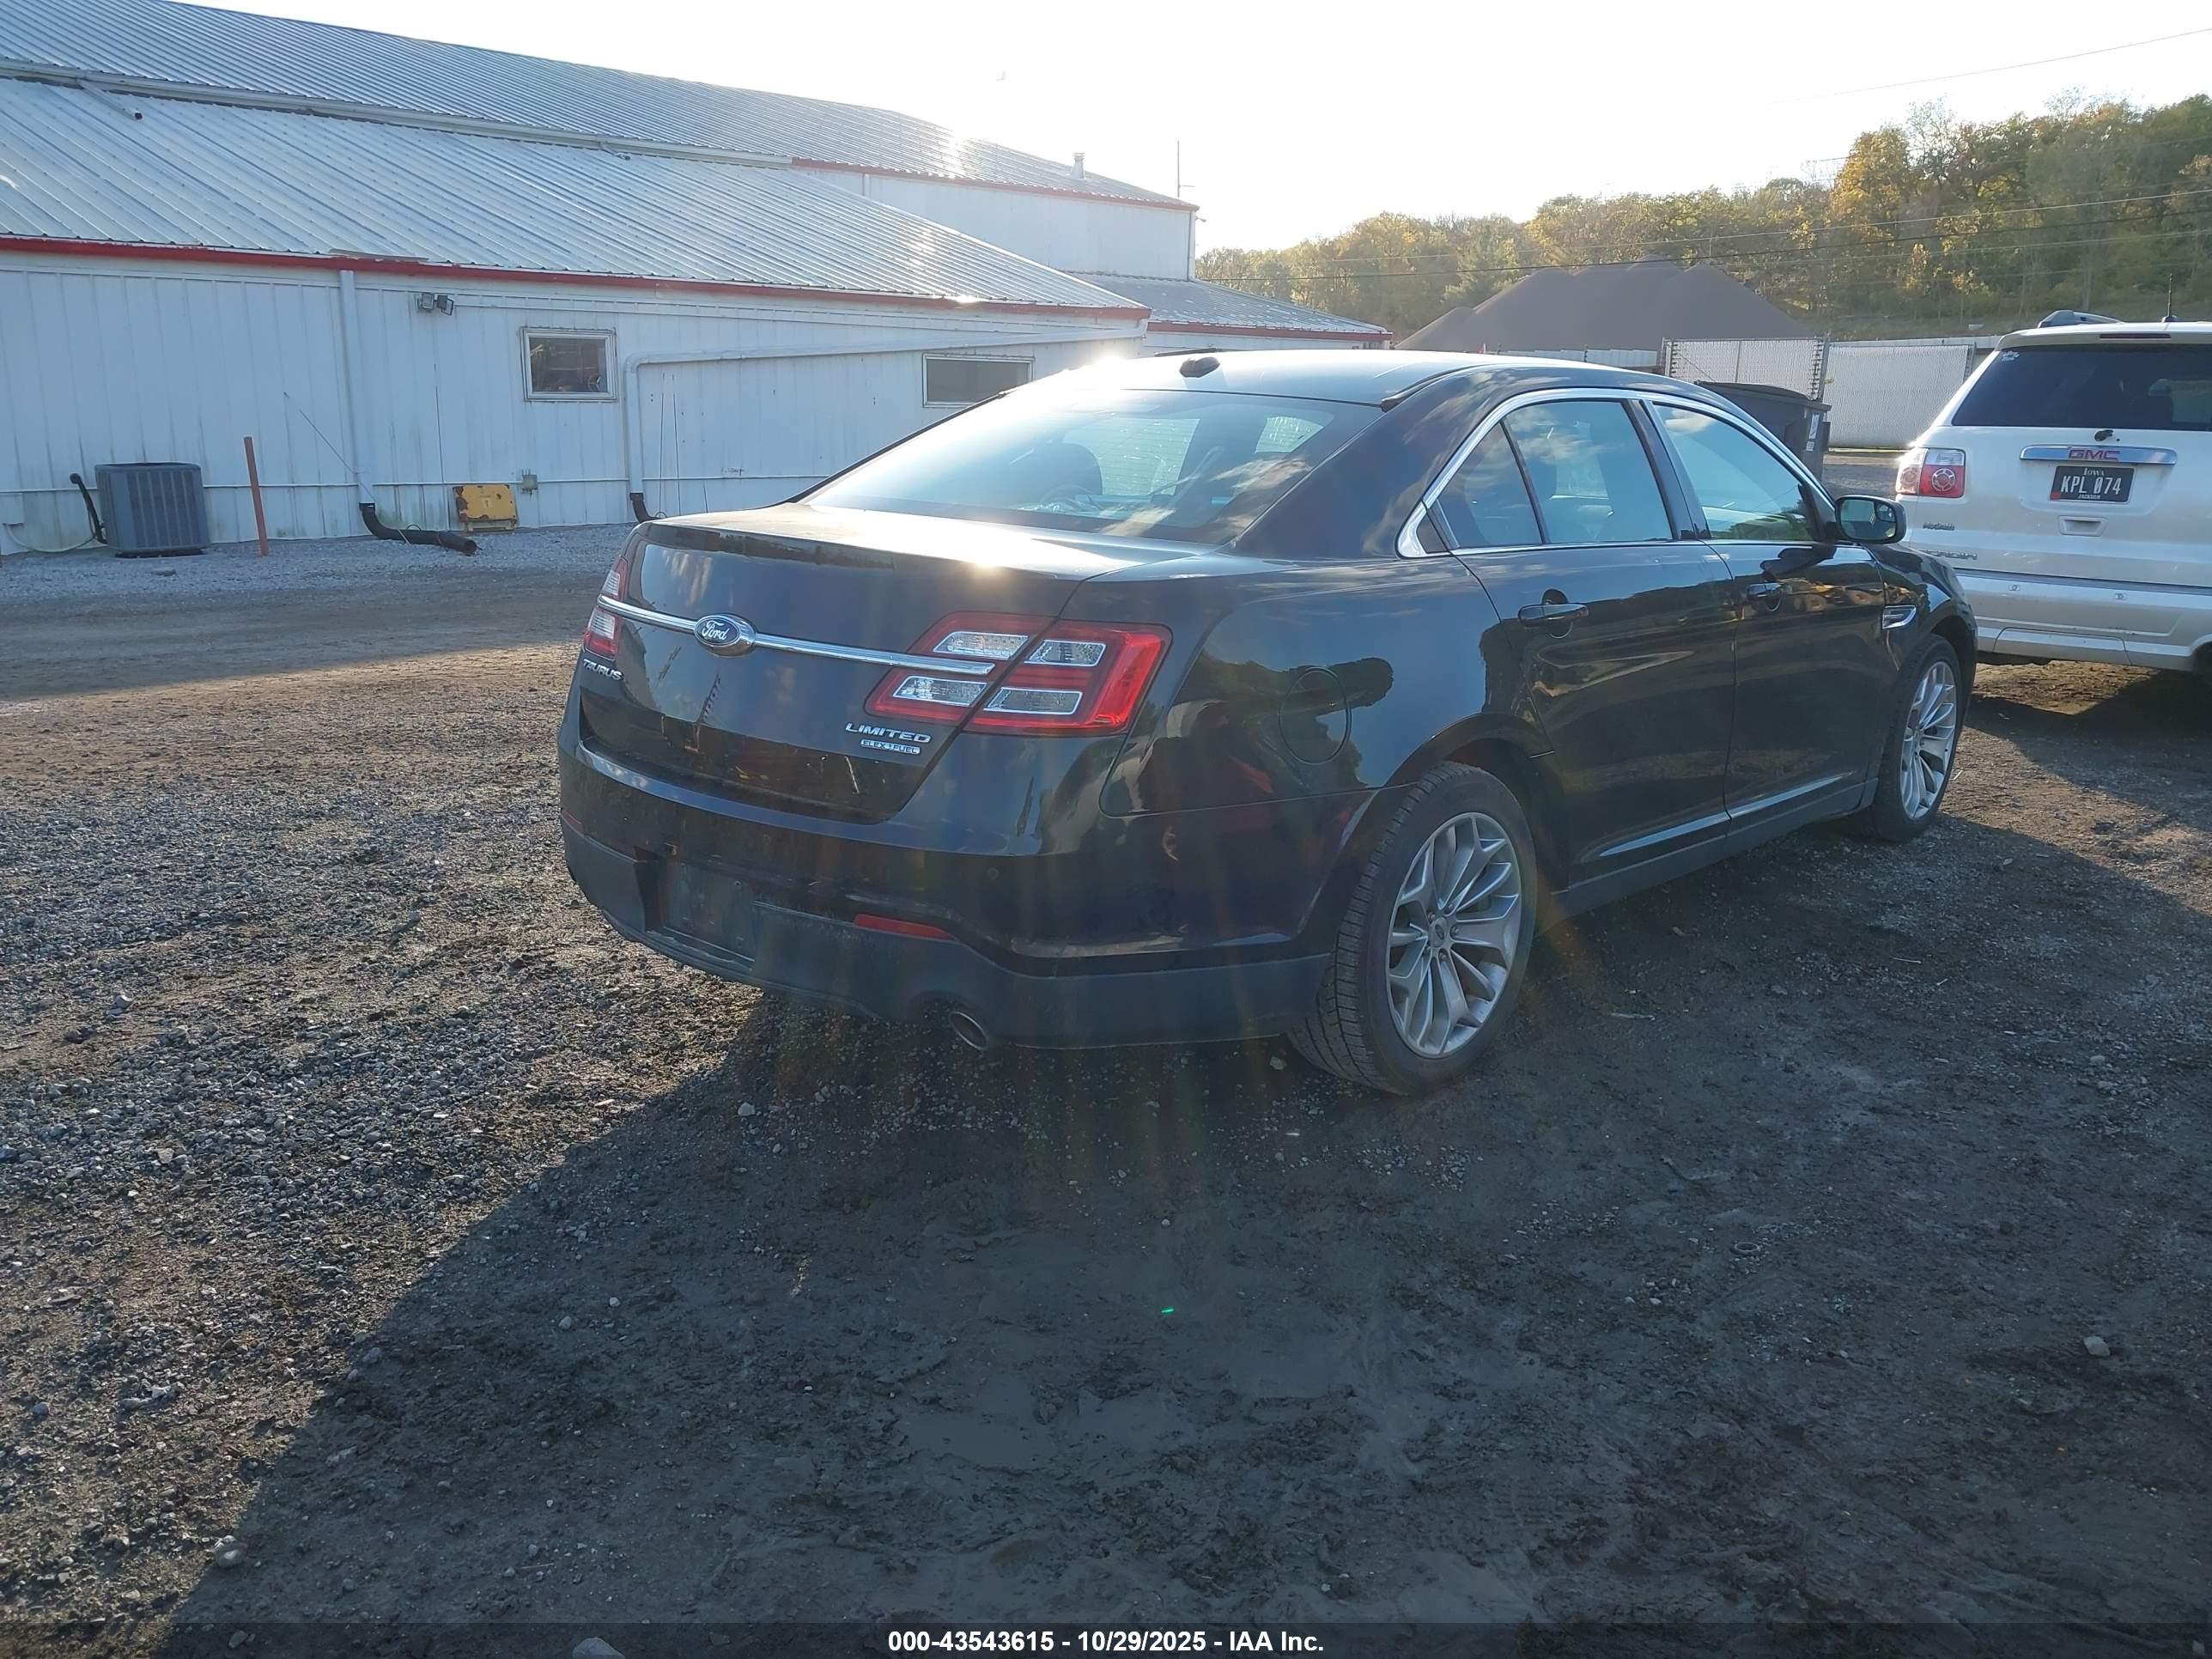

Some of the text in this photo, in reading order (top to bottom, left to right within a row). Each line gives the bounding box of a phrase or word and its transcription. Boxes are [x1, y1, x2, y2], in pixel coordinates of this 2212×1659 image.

[2068, 448, 2121, 462] GMC
[2061, 476, 2122, 495] KPL 074
[701, 620, 731, 641] Ford
[583, 659, 624, 681] TAURUS
[845, 722, 932, 744] LIMITED
